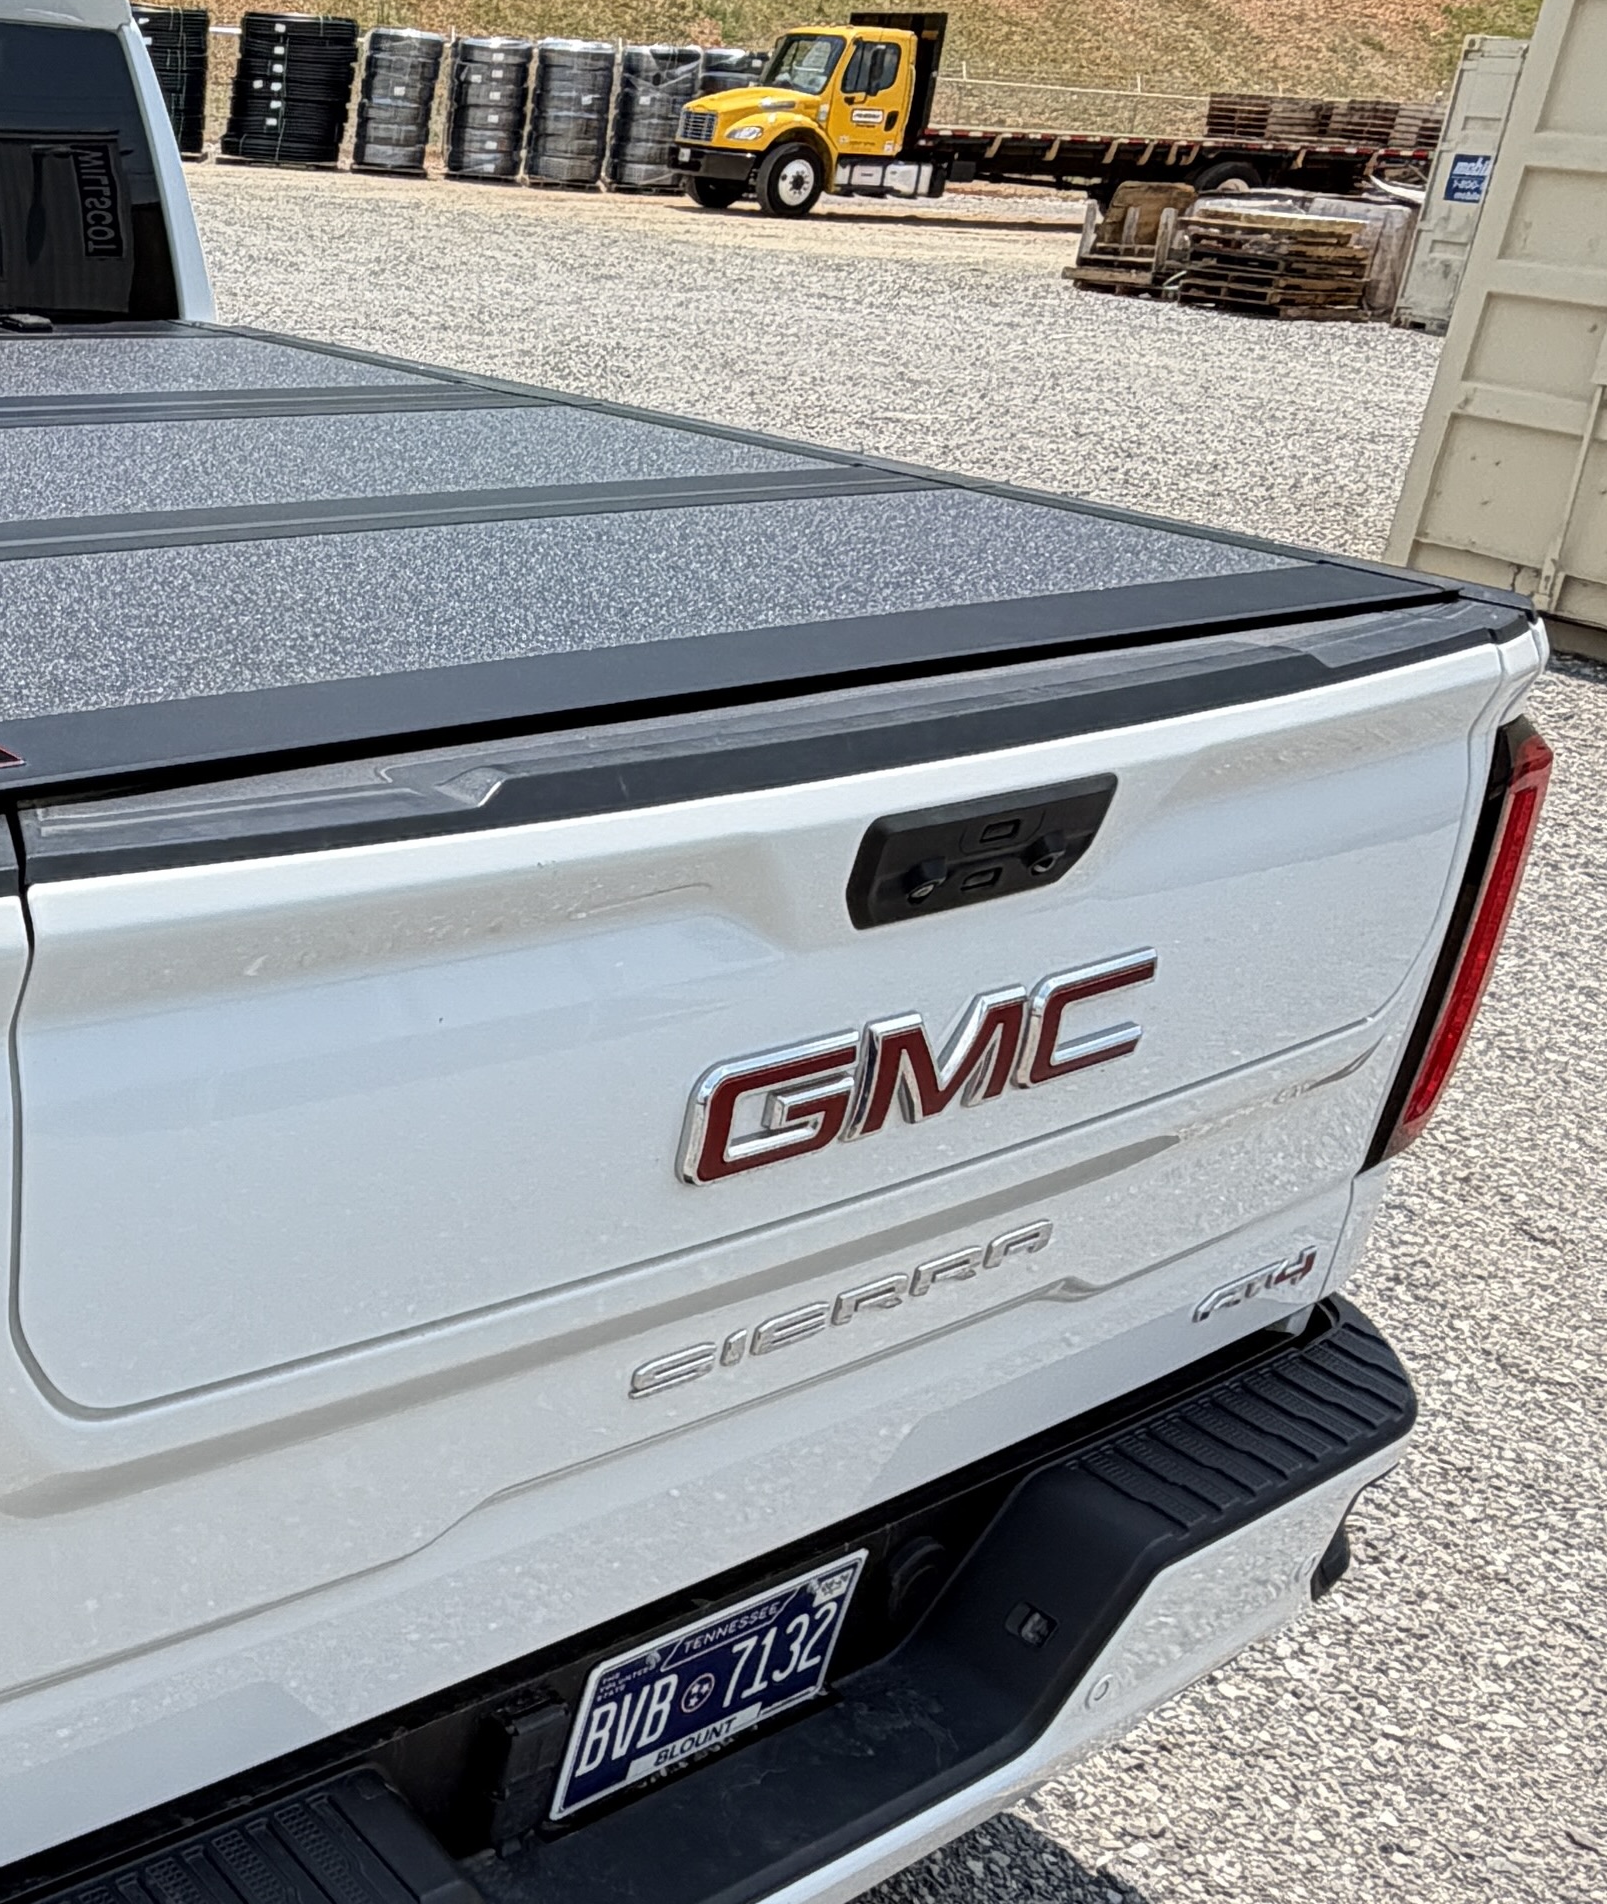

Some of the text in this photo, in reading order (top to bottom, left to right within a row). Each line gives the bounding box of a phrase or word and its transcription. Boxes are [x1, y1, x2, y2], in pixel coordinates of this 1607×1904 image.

[675, 946, 1158, 1185] GMC
[628, 1219, 1052, 1399] SIERRA
[1192, 1245, 1317, 1323] AT4
[575, 1602, 837, 1777] BVB 7132
[684, 1603, 781, 1654] TENNESSEE
[653, 1717, 737, 1765] BLOUNT
